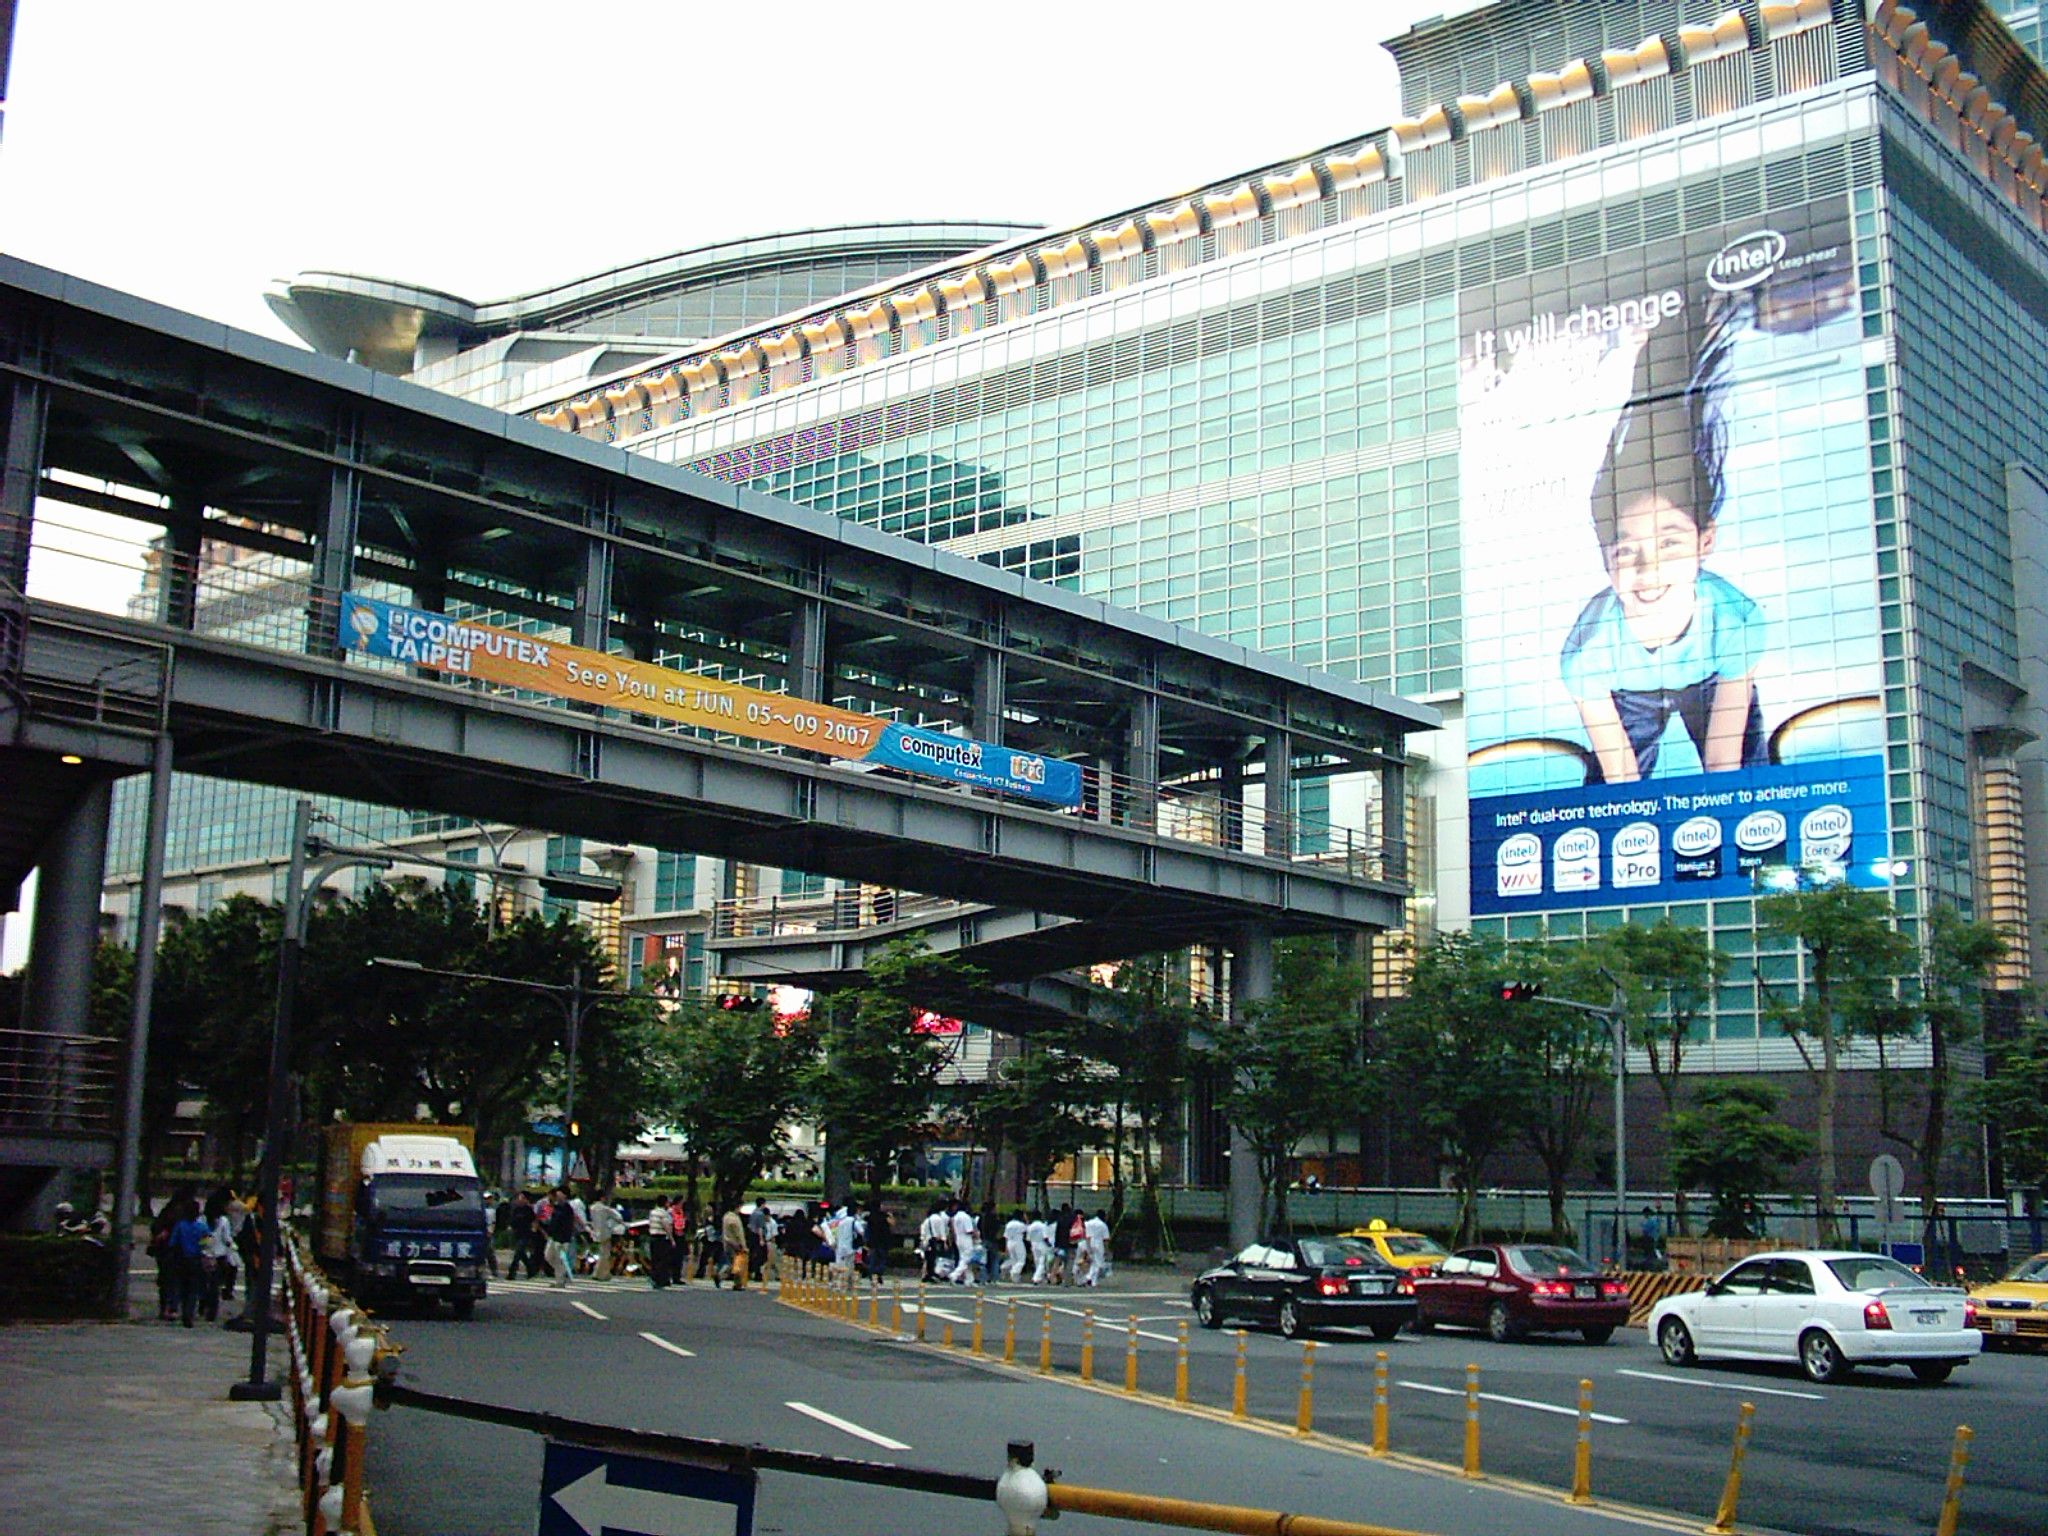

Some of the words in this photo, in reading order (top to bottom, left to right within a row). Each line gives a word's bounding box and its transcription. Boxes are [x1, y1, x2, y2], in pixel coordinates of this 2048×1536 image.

[1716, 239, 1777, 277] intel
[1475, 329, 1495, 361] It
[1505, 312, 1555, 353] will
[1563, 290, 1683, 338] change
[388, 634, 473, 673] TAIPEI
[409, 615, 550, 668] COMPUTEX
[566, 661, 609, 690] See
[615, 671, 657, 701] You
[664, 686, 686, 707] at
[691, 689, 741, 720] JUN.
[824, 719, 870, 748] 2007
[1530, 805, 1585, 825] dual-core
[1588, 798, 1662, 820] technology.
[1663, 795, 1690, 811] The
[1692, 792, 1735, 812] power
[1737, 790, 1753, 804] to
[1755, 784, 1808, 802] achieve
[1811, 781, 1852, 796] more.
[1744, 822, 1776, 837] intel
[1810, 816, 1842, 832] intel
[1621, 833, 1650, 849] intel
[1682, 829, 1711, 843] intel
[1505, 844, 1533, 859] intel
[1562, 839, 1590, 853] intel
[1804, 846, 1831, 858] Core
[1832, 844, 1841, 855] 2
[1617, 863, 1657, 879] vPro
